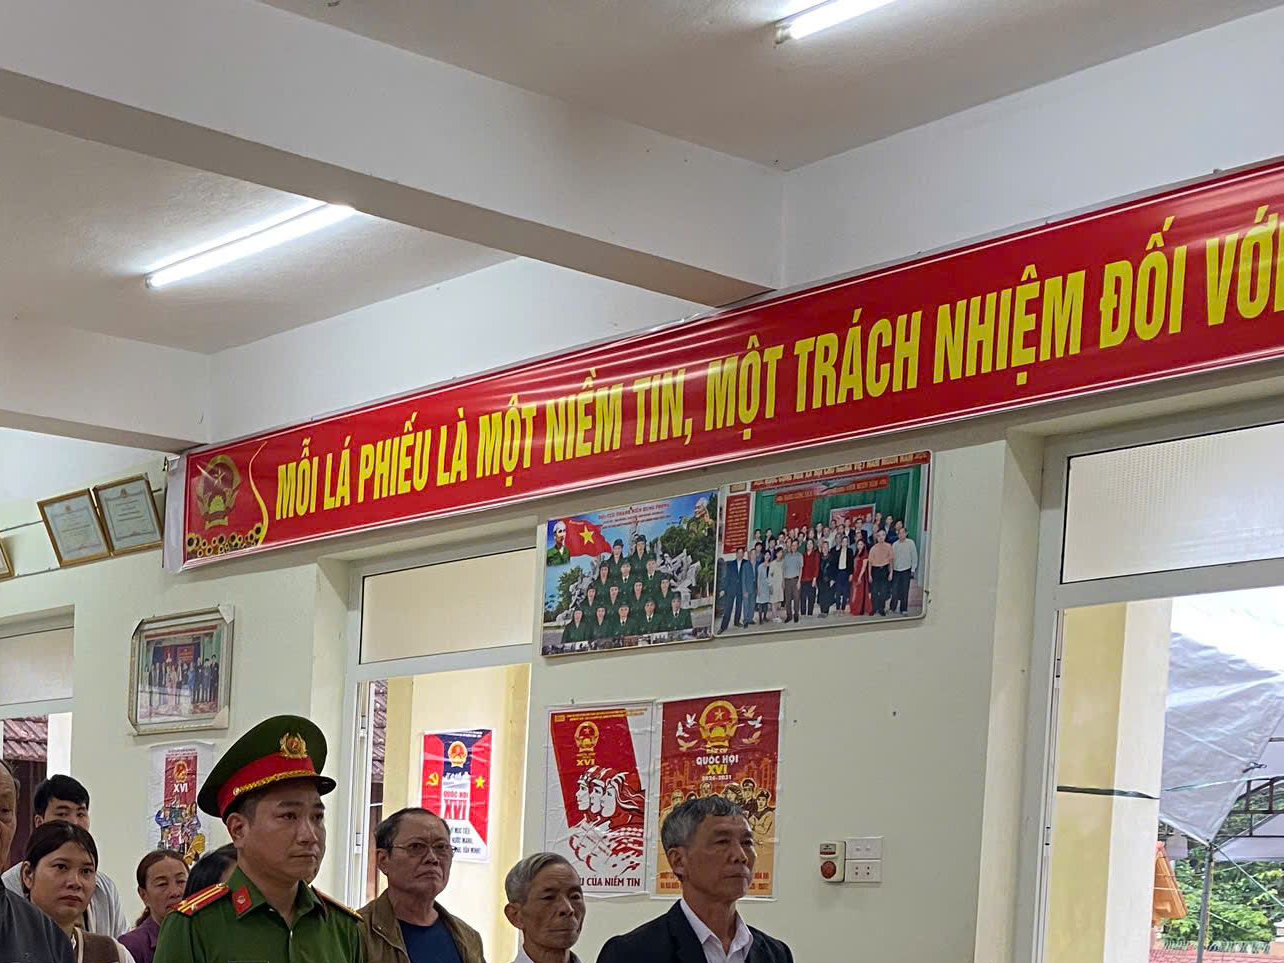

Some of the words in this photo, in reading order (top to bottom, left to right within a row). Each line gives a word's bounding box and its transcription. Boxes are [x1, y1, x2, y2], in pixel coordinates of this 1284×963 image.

[275, 436, 319, 521] MỖI
[323, 436, 351, 511] LÁ
[357, 411, 433, 504] PHIẾU
[436, 407, 468, 487] LÀ
[476, 392, 538, 488] MỘT
[544, 367, 623, 465] NIỀM
[633, 366, 693, 446] TIN,
[704, 335, 784, 441] MỘT
[793, 307, 923, 413] TRÁCH
[932, 263, 1086, 386] NHIỆM
[1099, 215, 1188, 349] ĐỐI
[696, 755, 720, 766] QUỐC
[722, 753, 739, 766] HỘI
[707, 764, 728, 775] XVI
[173, 783, 188, 793] XVI
[444, 799, 467, 820] XVI
[587, 874, 603, 887] CỦA
[627, 877, 640, 887] TIN
